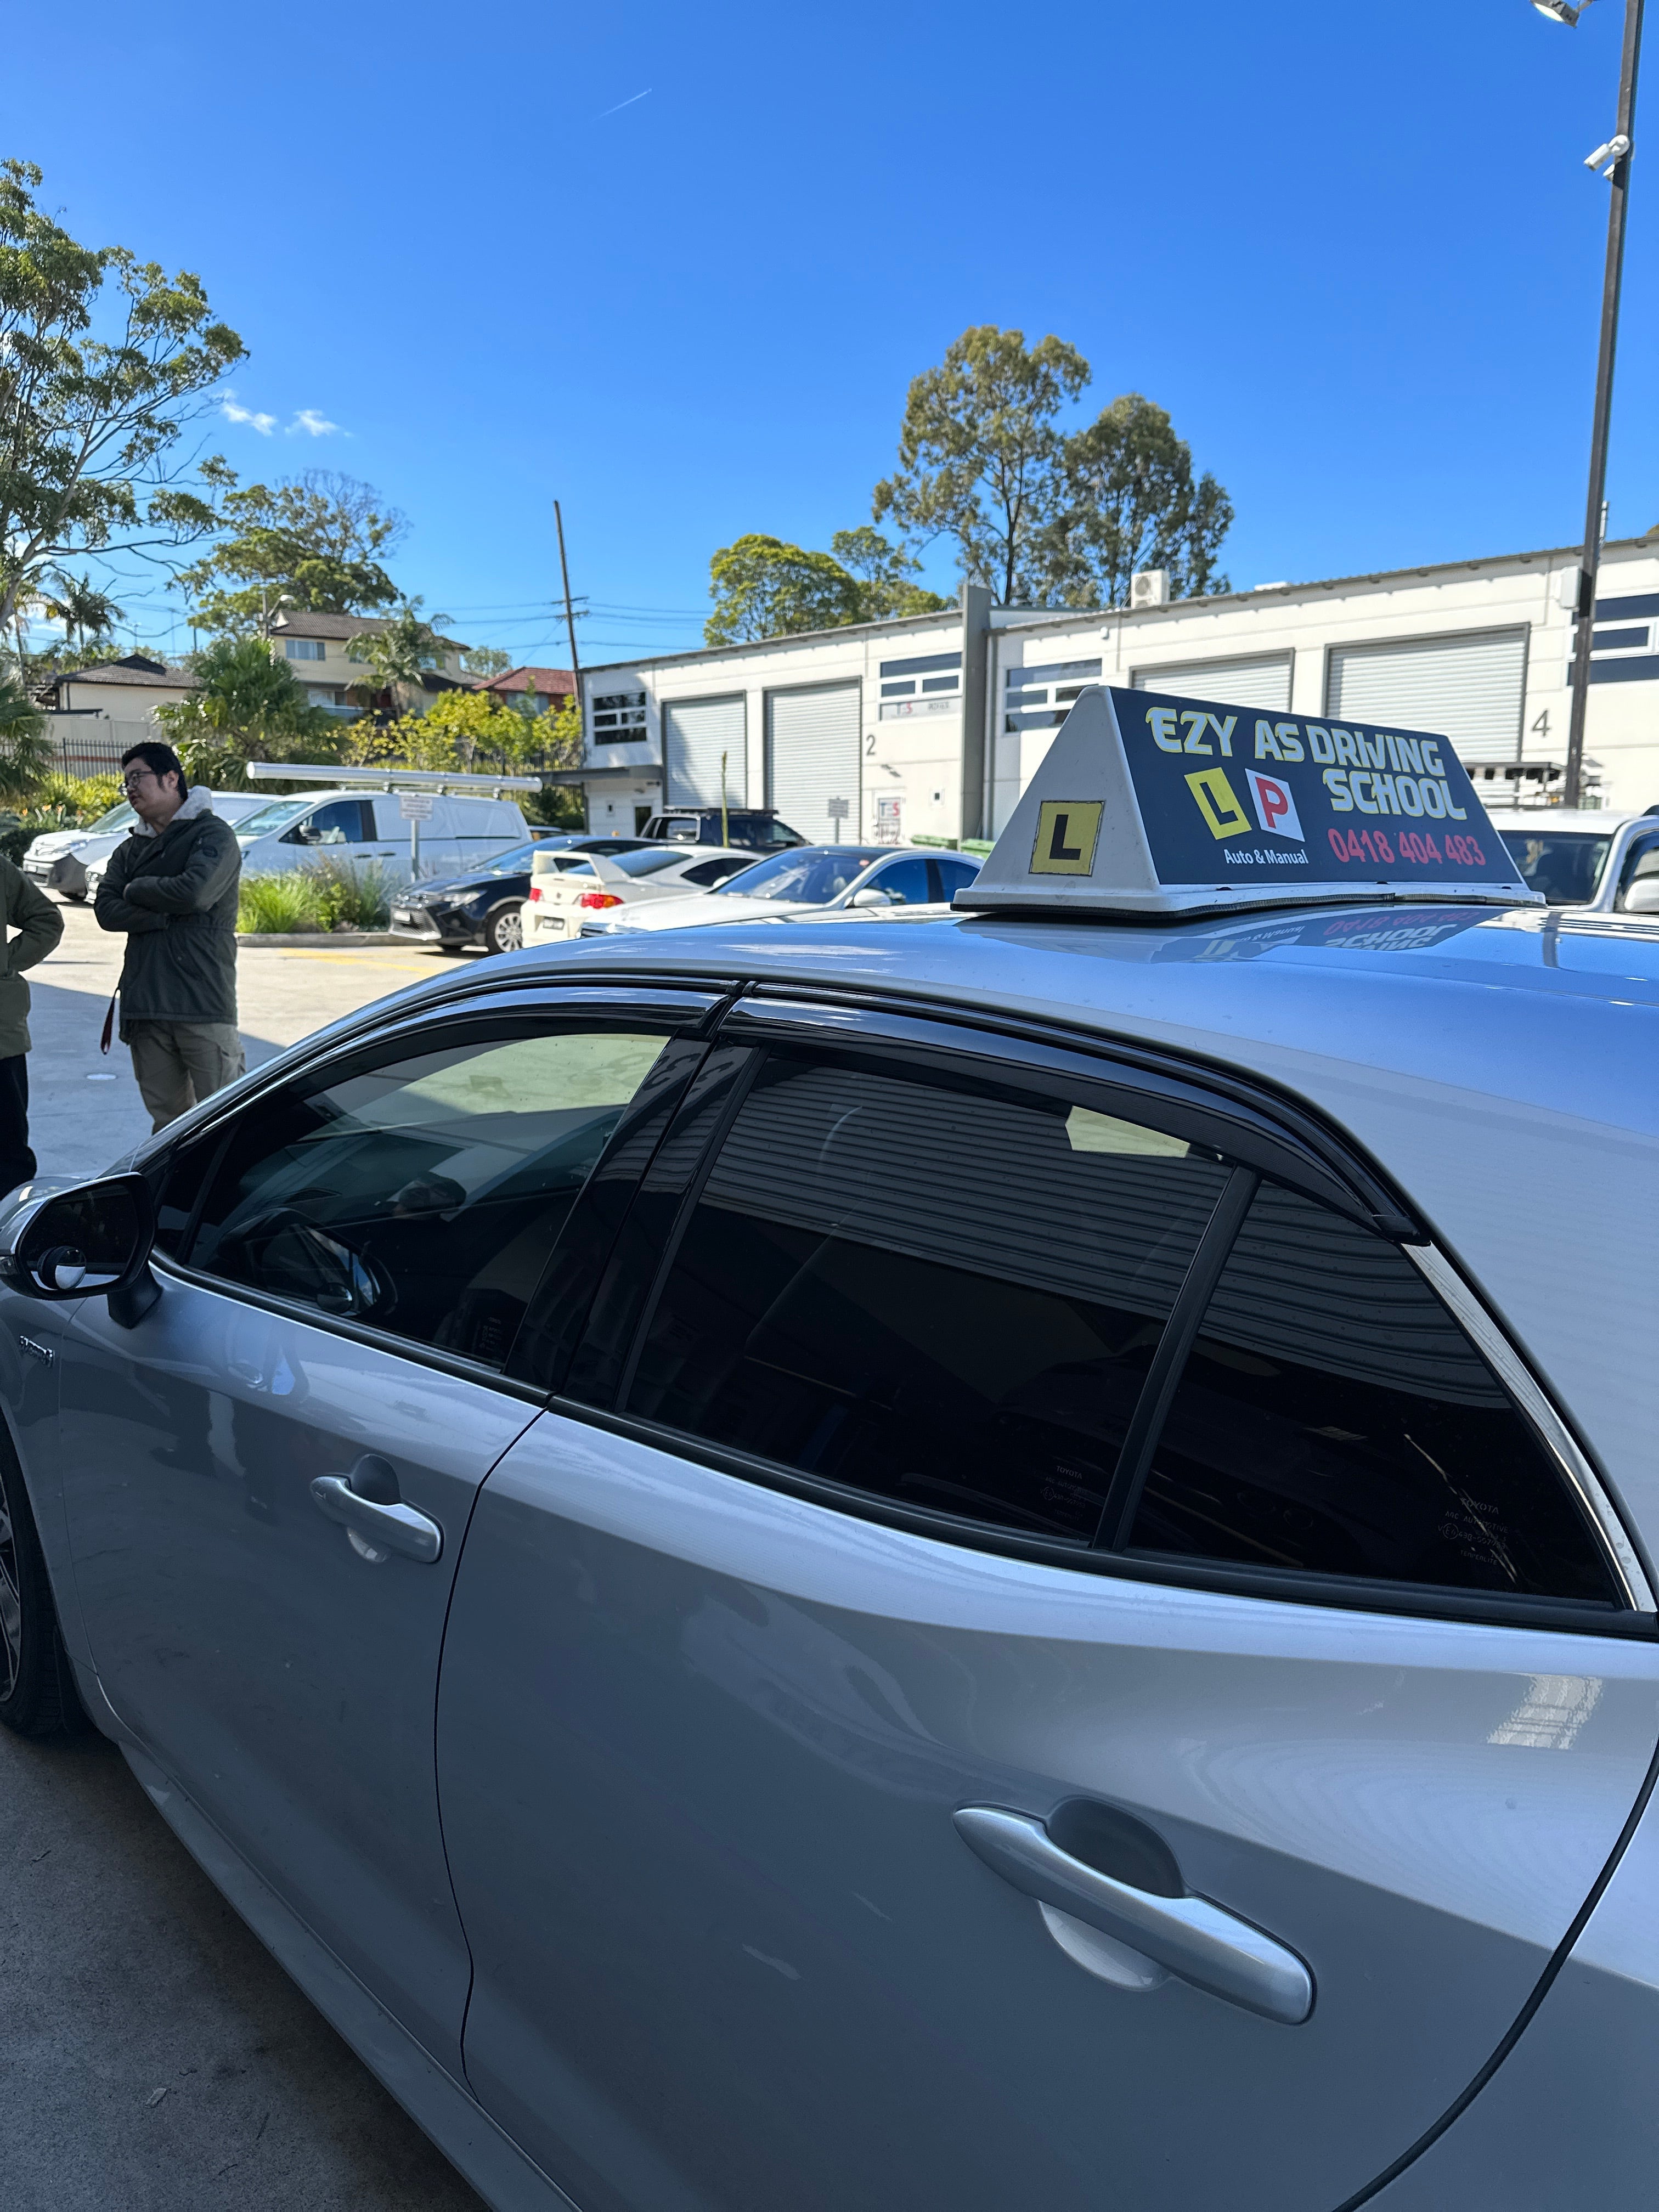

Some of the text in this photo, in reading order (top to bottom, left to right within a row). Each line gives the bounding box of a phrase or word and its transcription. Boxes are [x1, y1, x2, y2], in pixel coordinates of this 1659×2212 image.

[1146, 707, 1446, 776] EZY AS DRIVING
[1532, 709, 1552, 737] 4
[866, 735, 876, 756] 2
[1199, 782, 1238, 825] L
[1255, 776, 1288, 829] P
[1323, 768, 1467, 820] SCHOOL
[1049, 815, 1081, 861] L
[1224, 849, 1309, 864] Auto & Manual
[1328, 828, 1486, 866] 0418 404 483
[1056, 1465, 1082, 1480] TOYOTA
[1462, 1498, 1499, 1514] TOYOTA
